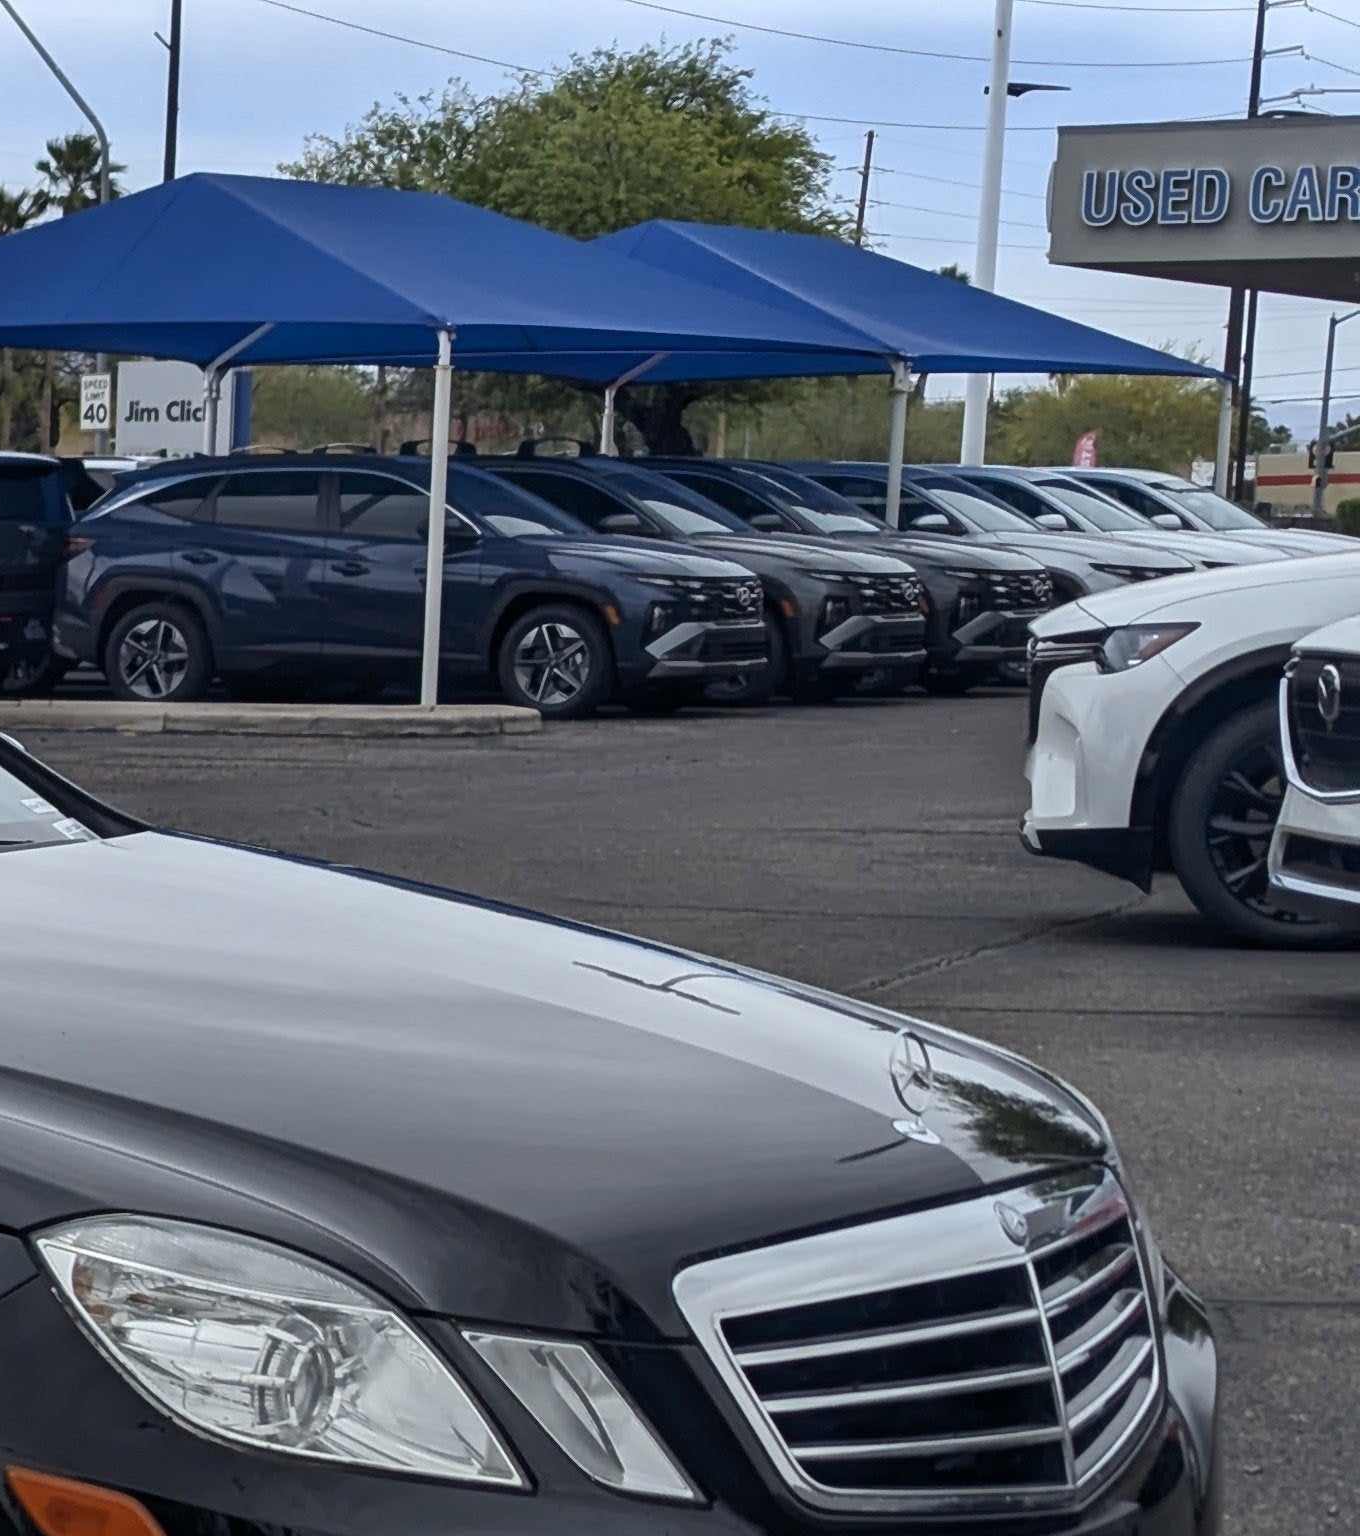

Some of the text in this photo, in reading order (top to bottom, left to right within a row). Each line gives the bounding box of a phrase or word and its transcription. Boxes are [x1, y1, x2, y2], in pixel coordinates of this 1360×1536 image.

[1081, 166, 1230, 227] USED
[83, 379, 108, 390] SPEED
[85, 391, 105, 401] LIMIT
[83, 403, 108, 424] 40
[124, 401, 159, 422] Jim
